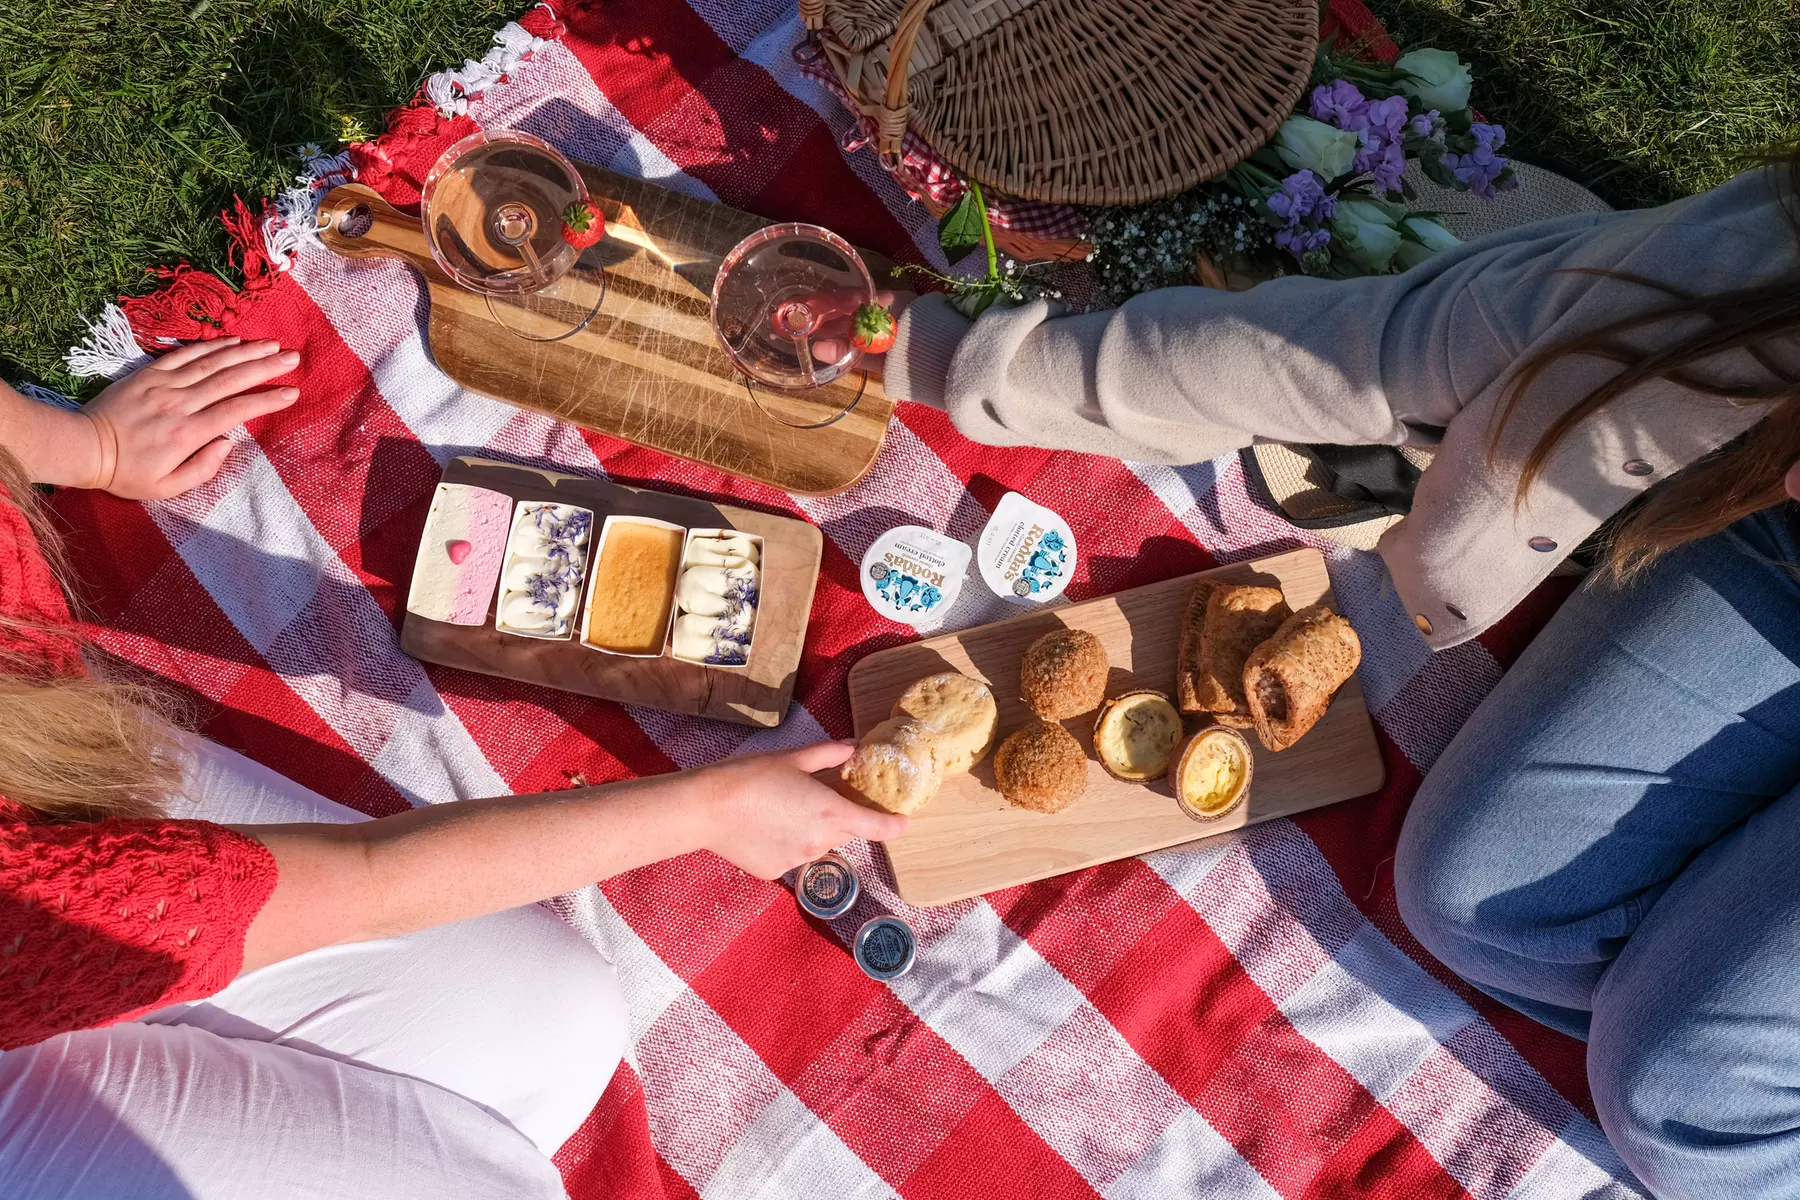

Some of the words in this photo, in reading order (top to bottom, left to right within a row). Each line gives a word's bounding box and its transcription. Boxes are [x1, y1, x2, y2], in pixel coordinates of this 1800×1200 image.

[1008, 521, 1025, 546] clotted
[894, 542, 918, 555] cream
[918, 552, 945, 566] clotted
[995, 546, 1010, 569] cream
[1004, 523, 1044, 581] Rodda's
[882, 552, 945, 587] Rodda's
